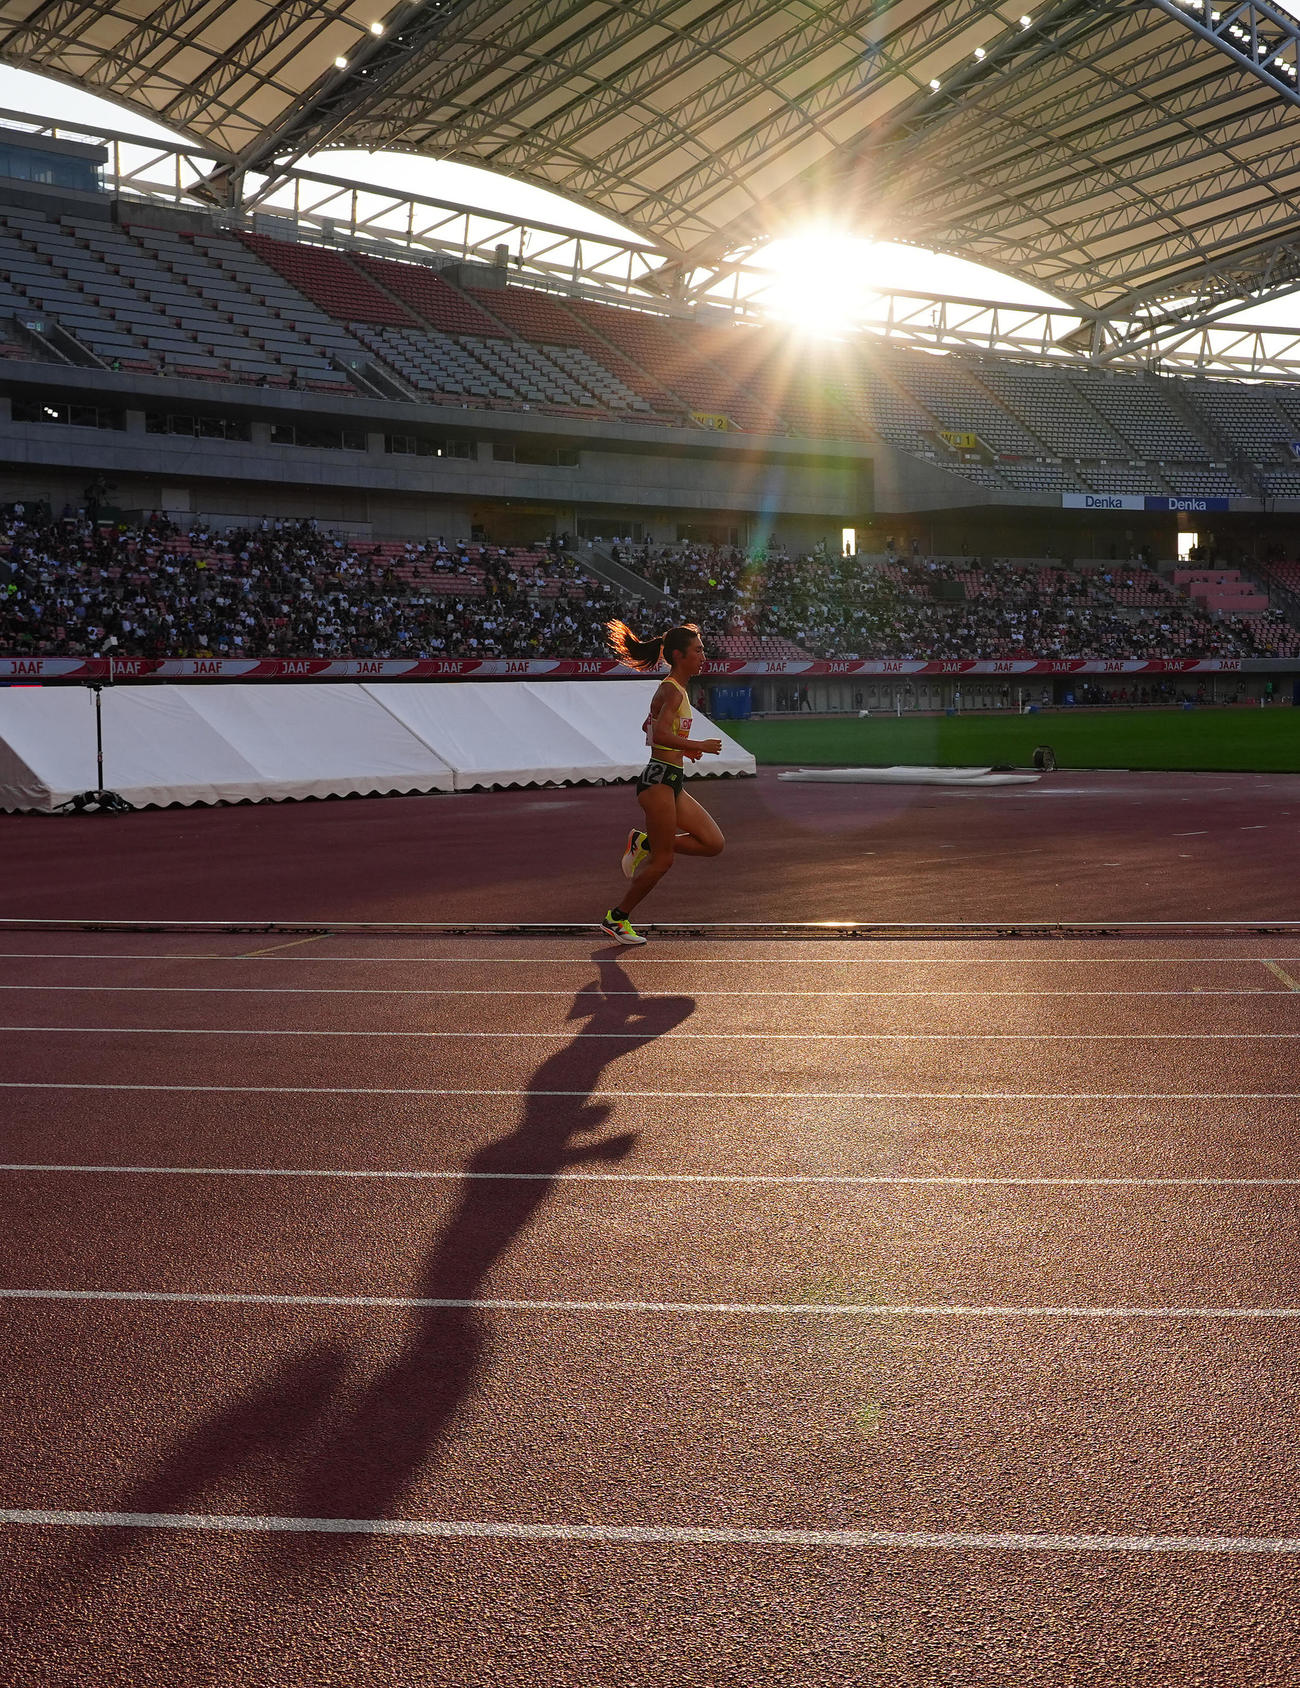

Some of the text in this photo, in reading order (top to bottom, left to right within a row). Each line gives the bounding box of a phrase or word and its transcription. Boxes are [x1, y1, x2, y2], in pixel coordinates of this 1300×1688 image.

[1085, 495, 1123, 509] Denka
[1168, 497, 1207, 511] Denka
[11, 661, 44, 674] JAAF
[193, 661, 223, 674] JAAF
[281, 661, 311, 674] JAAF
[356, 662, 384, 674] JAAF
[437, 662, 463, 673] JAAF
[505, 662, 530, 673] JAAF
[578, 662, 602, 673] JAAF
[707, 662, 730, 673] JAAF
[765, 662, 788, 672] JAAF
[828, 662, 850, 672] JAAF
[882, 662, 903, 672] JAAF
[941, 662, 962, 672] JAAF
[993, 662, 1014, 672] JAAF
[1051, 662, 1072, 672] JAAF
[1103, 662, 1125, 672] JAAF
[1163, 661, 1185, 671] JAAF
[1218, 660, 1240, 671] JAAF
